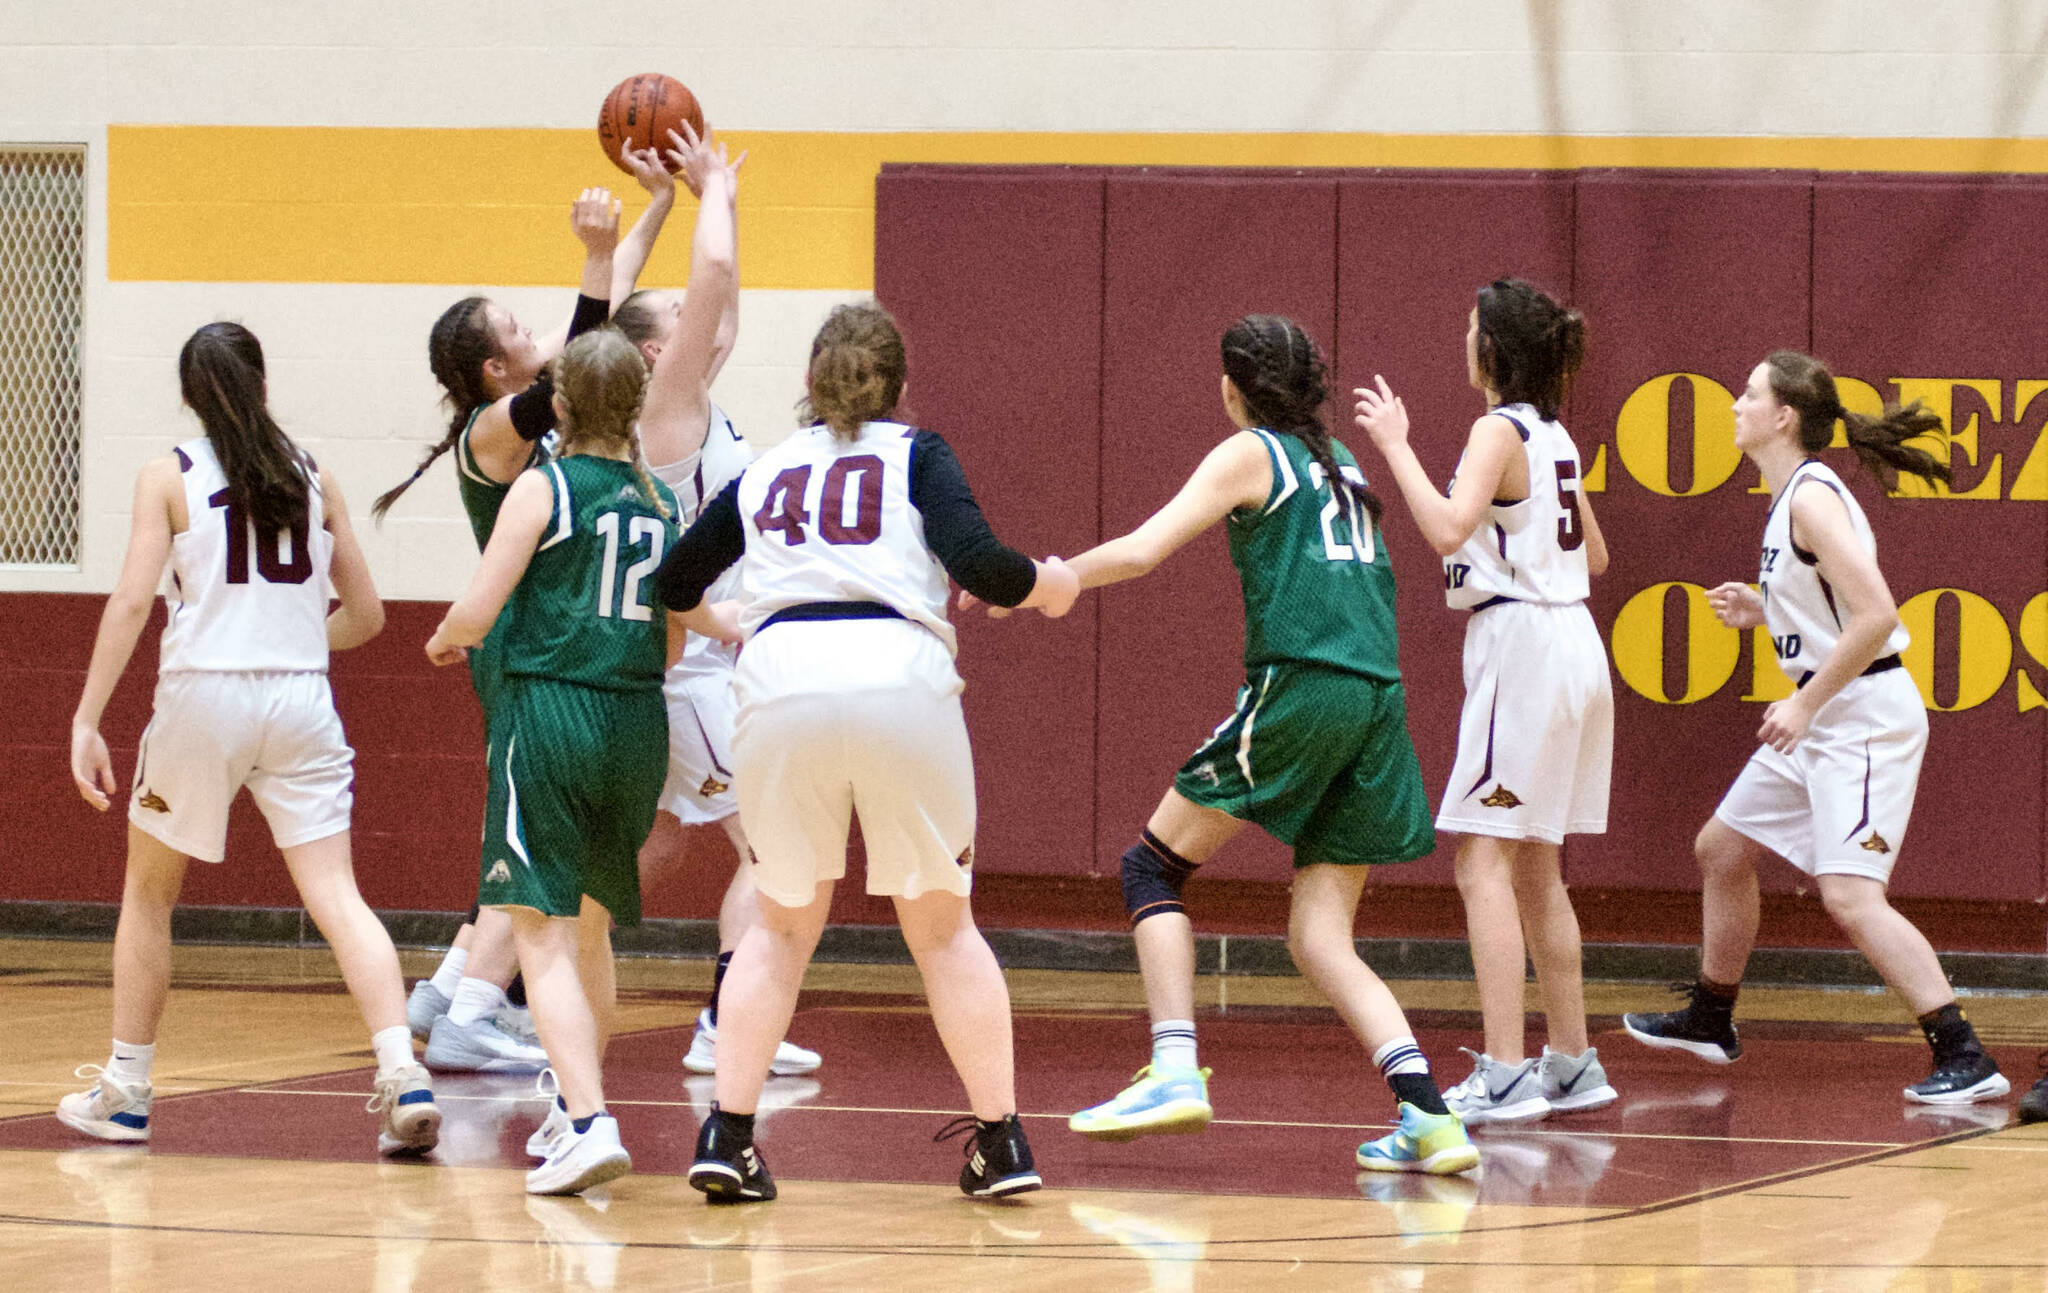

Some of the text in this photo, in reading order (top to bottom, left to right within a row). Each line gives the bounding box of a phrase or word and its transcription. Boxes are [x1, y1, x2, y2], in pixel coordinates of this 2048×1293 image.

[208, 486, 314, 585] 10
[754, 454, 885, 547] 40
[1308, 461, 1375, 564] 20
[1554, 459, 1585, 552] 5
[595, 511, 666, 622] 12
